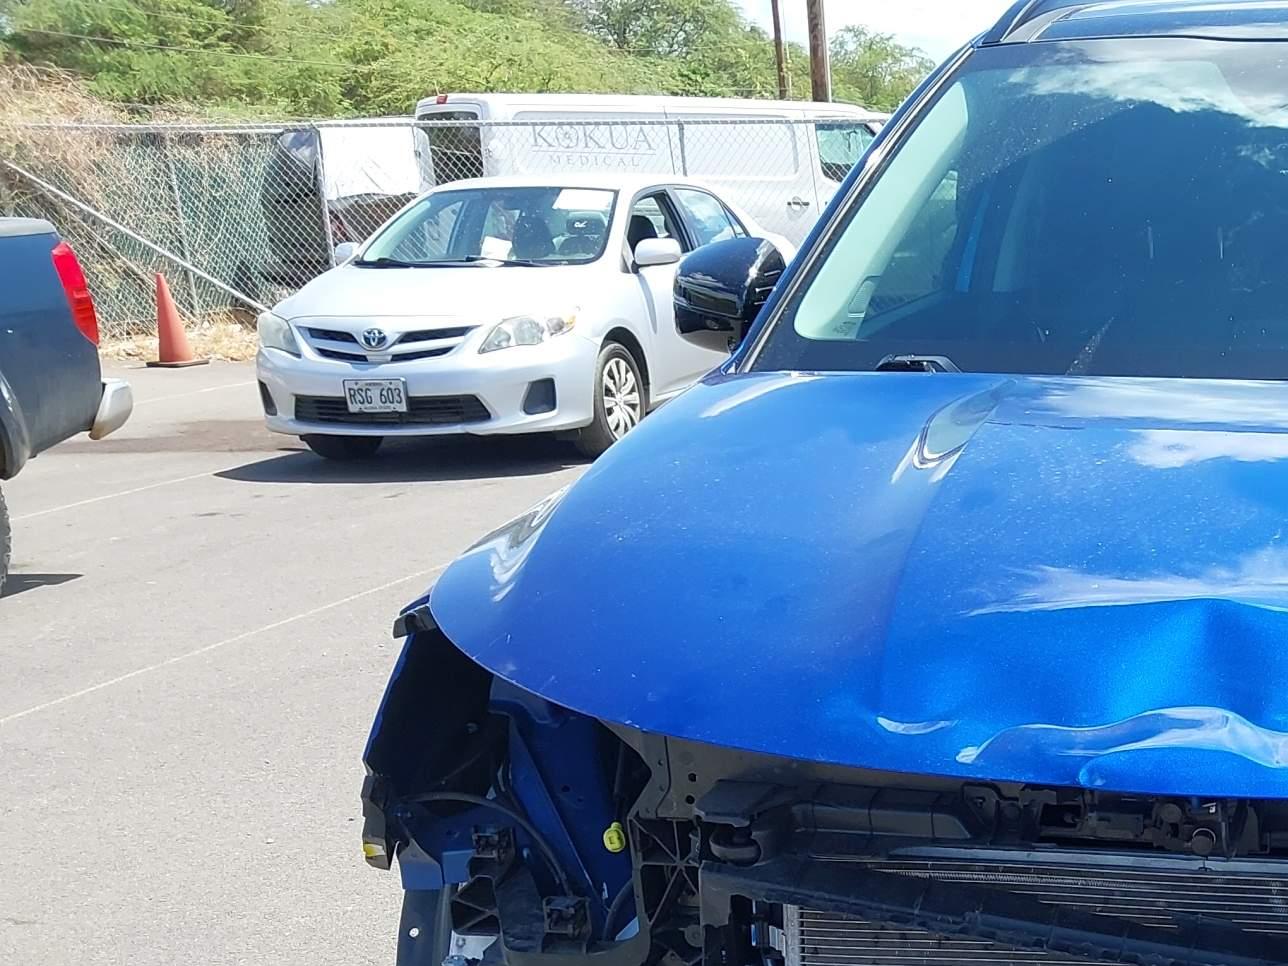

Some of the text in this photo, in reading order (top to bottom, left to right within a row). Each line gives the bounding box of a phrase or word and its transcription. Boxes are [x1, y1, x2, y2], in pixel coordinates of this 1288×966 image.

[530, 123, 657, 151] KOKUA
[549, 154, 642, 168] MEDICAL
[348, 387, 403, 405] RSG 603
